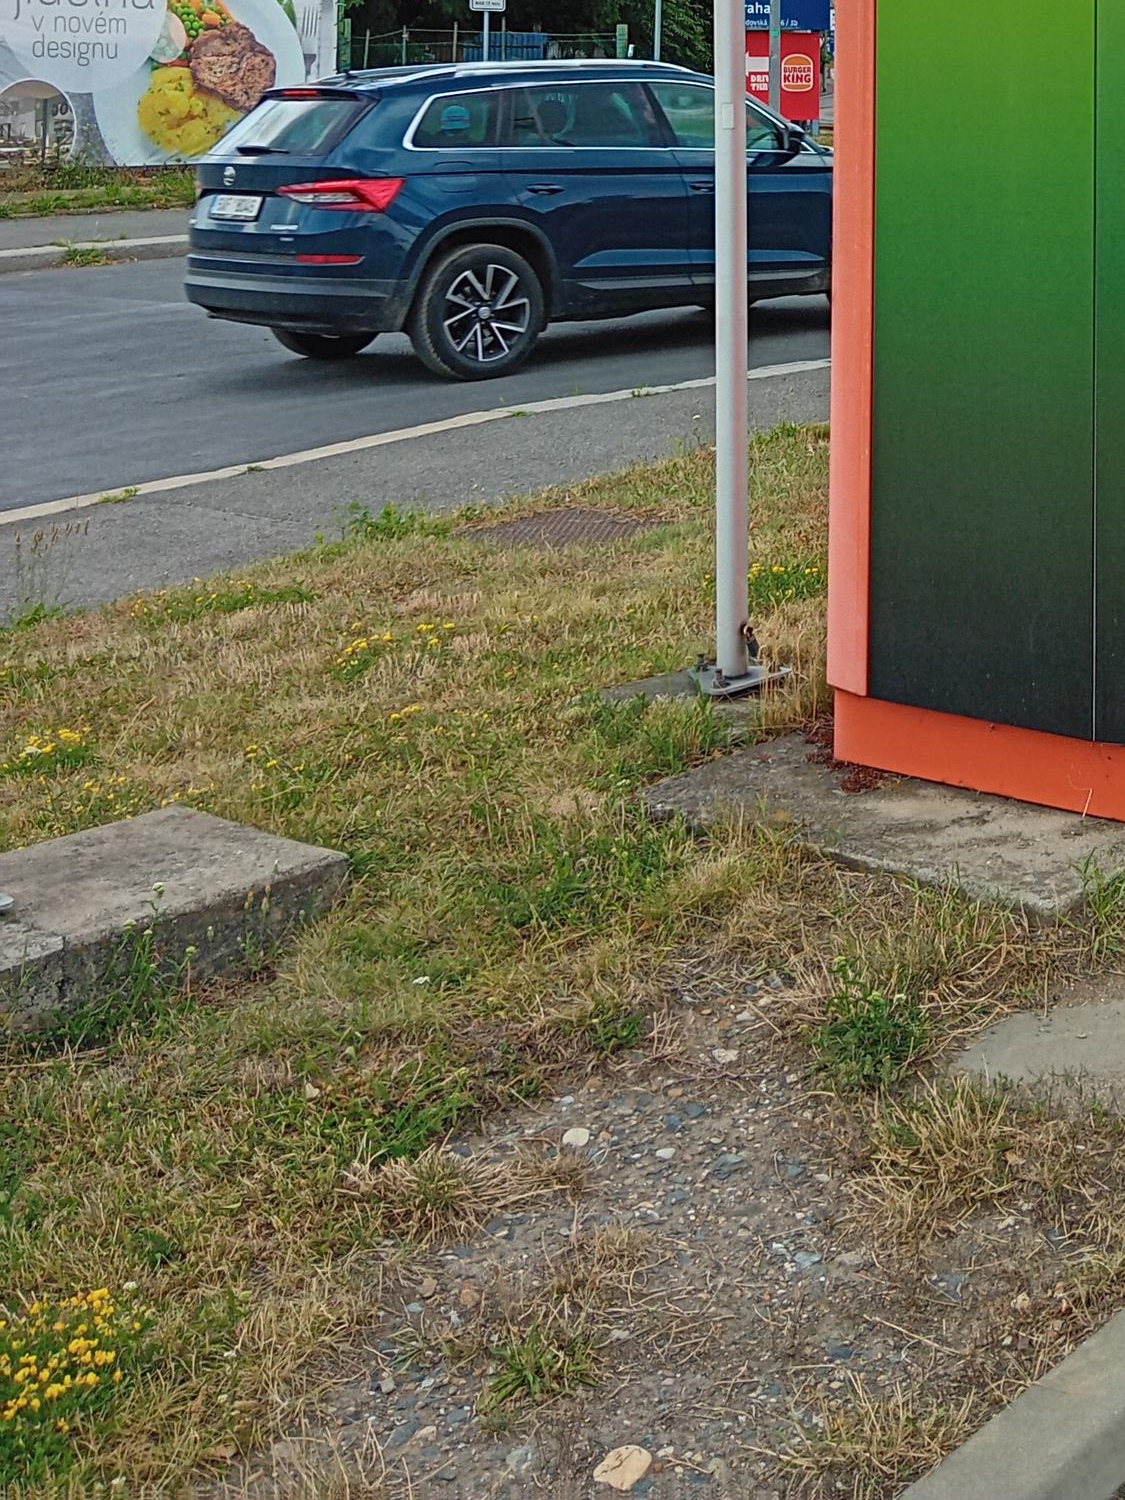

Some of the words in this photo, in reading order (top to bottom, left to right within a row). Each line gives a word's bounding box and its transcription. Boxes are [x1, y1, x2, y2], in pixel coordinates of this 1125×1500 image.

[32, 15, 44, 32] v
[54, 11, 127, 34] novém
[32, 34, 118, 66] designu
[783, 66, 811, 74] BURGER
[783, 74, 811, 84] KING
